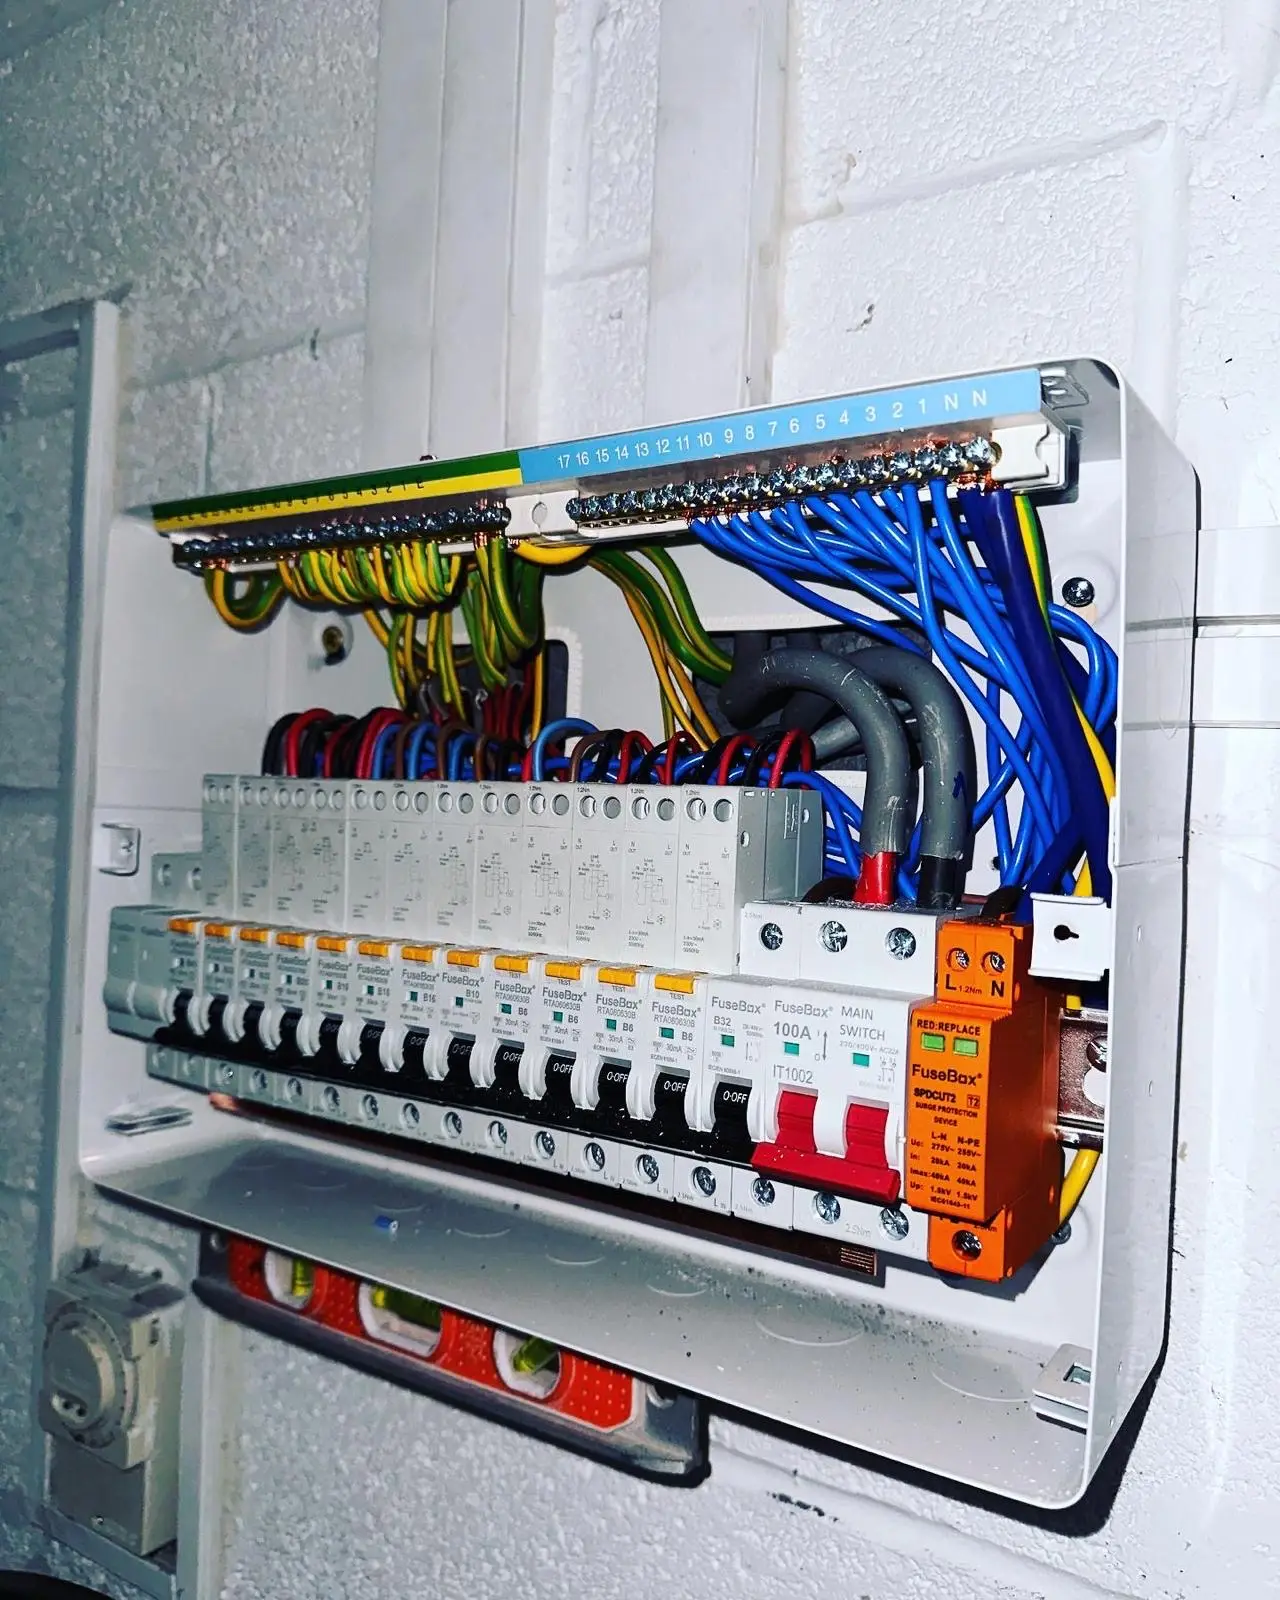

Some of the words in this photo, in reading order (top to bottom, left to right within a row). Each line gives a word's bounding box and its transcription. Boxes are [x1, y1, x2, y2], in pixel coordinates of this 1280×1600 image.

[558, 455, 570, 469] 17
[576, 453, 590, 466] 16
[595, 449, 610, 464] 15
[615, 446, 629, 460] 14
[634, 442, 649, 457] 13
[656, 439, 671, 454] 12
[676, 435, 690, 451] 11
[697, 432, 713, 447] 10
[724, 428, 733, 444] 9
[745, 425, 755, 440] 8
[767, 421, 778, 437] 7
[789, 418, 800, 433] 6
[816, 414, 826, 429] 5
[839, 410, 849, 425] 4
[865, 407, 877, 422] 3
[892, 402, 903, 418] 2
[918, 398, 926, 414] 1
[944, 393, 959, 411] N
[972, 389, 987, 407] N
[945, 974, 957, 991] L
[959, 985, 982, 995] 1.2Nm
[991, 980, 1005, 997] N
[466, 989, 480, 999] B10
[518, 1007, 528, 1016] B6
[841, 1005, 874, 1020] MAIN
[568, 1014, 579, 1023] B6
[714, 1015, 731, 1026] B32
[623, 1022, 634, 1032] B6
[774, 1021, 811, 1040] 100A
[839, 1024, 885, 1041] SWITCH
[916, 1019, 981, 1036] RED:REPLACE
[681, 1031, 693, 1041] B6
[773, 1064, 813, 1084] IT1002
[914, 1087, 956, 1103] SPDCUT2
[938, 1105, 978, 1118] PROTECTION
[934, 1116, 958, 1127] DEVICE
[957, 1136, 980, 1147] N-PE
